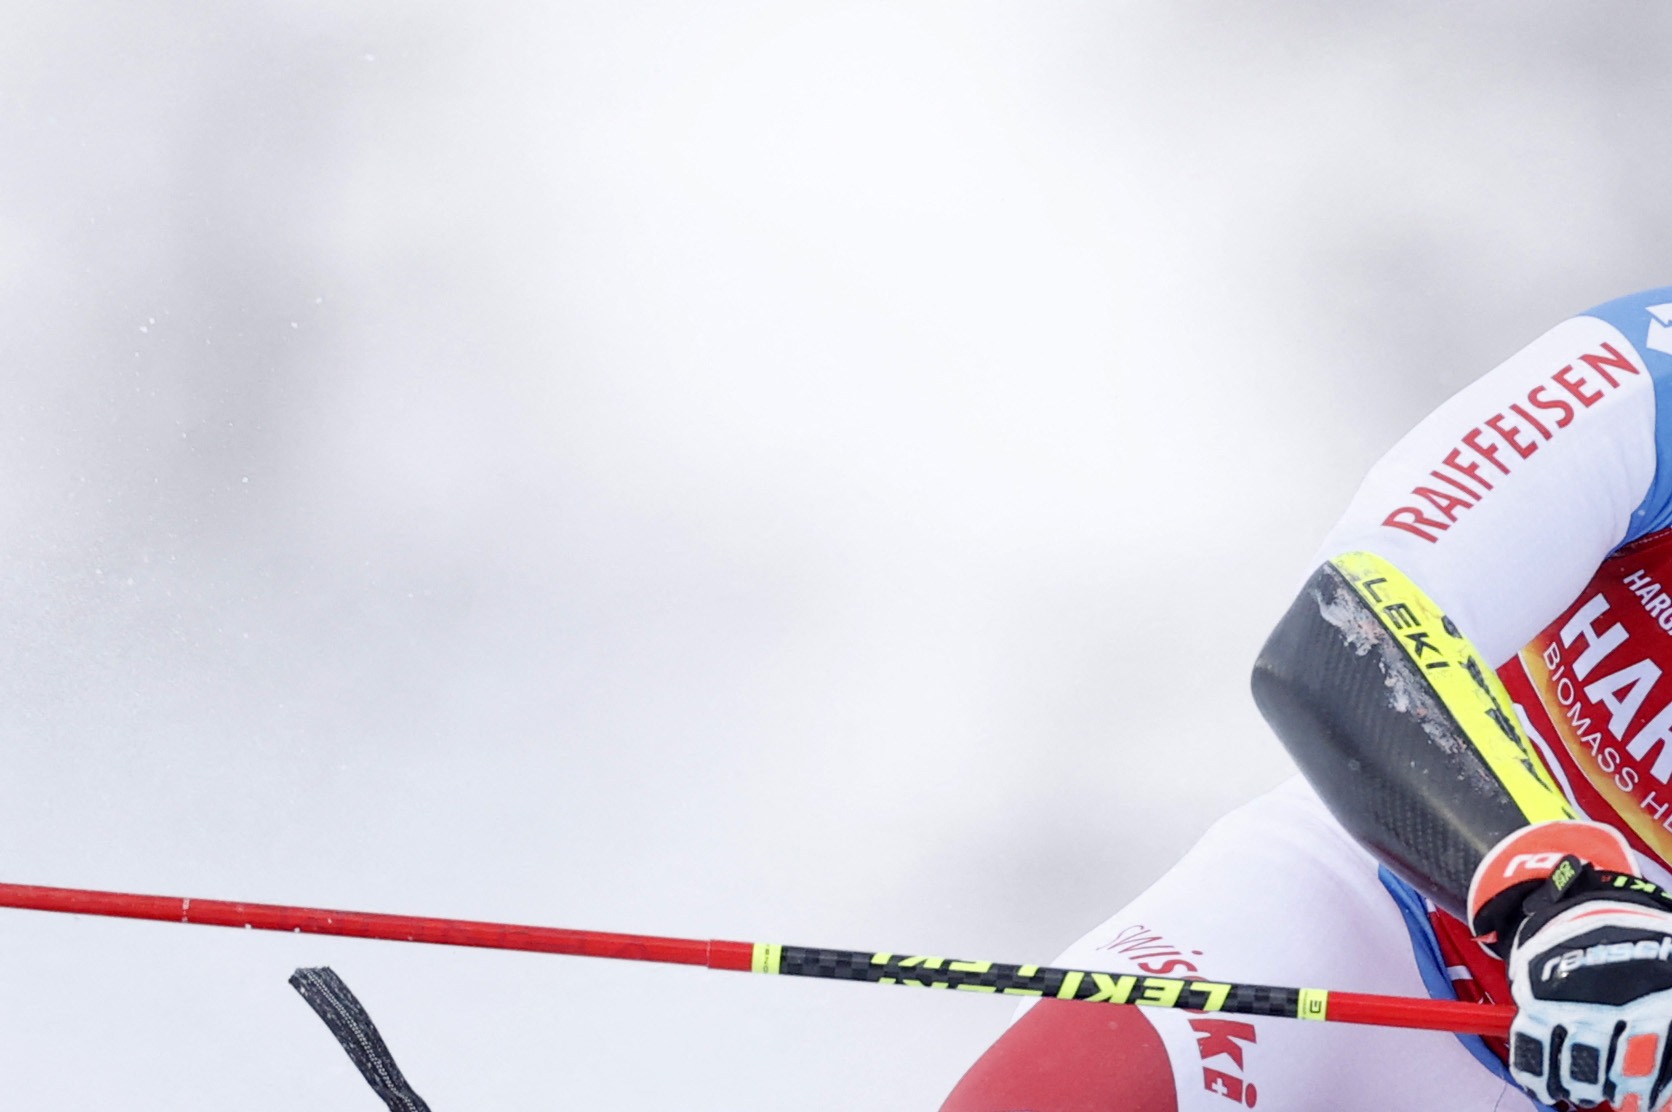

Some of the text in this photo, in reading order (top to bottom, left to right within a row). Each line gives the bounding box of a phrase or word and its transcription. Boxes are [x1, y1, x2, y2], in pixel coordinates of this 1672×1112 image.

[1380, 340, 1642, 544] RAIFFEISEN
[1361, 576, 1450, 671] LEKI
[1542, 640, 1636, 794] BIOMASS
[1056, 970, 1232, 1013] LEKI
